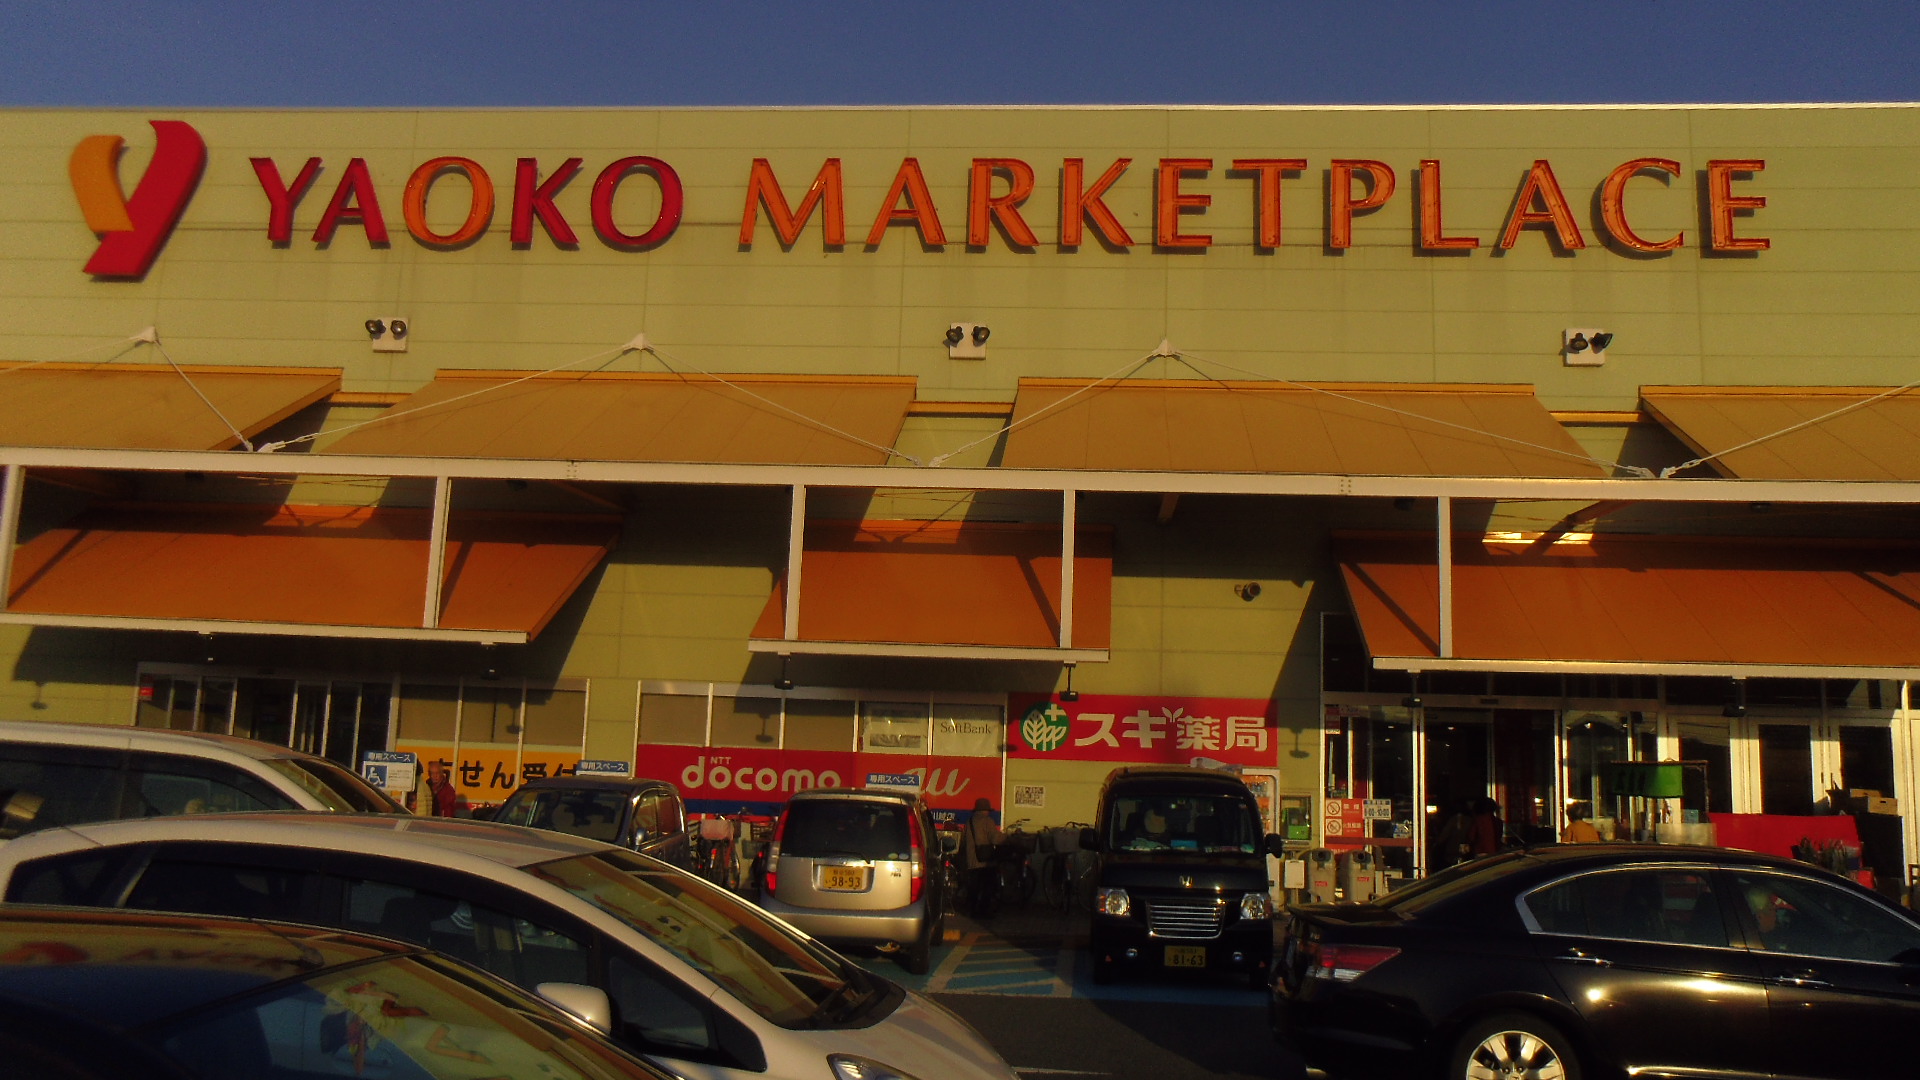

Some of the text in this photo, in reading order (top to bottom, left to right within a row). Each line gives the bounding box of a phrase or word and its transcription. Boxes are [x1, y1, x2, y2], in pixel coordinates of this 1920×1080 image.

[249, 155, 1769, 255] YAOKO MARKETPLACE
[940, 721, 992, 735] SoftBank
[367, 752, 411, 763] 専用スペース
[710, 756, 732, 765] NTT
[580, 760, 625, 772] 専用スペース
[681, 756, 842, 792] docomo
[869, 774, 916, 785] 専用スペース
